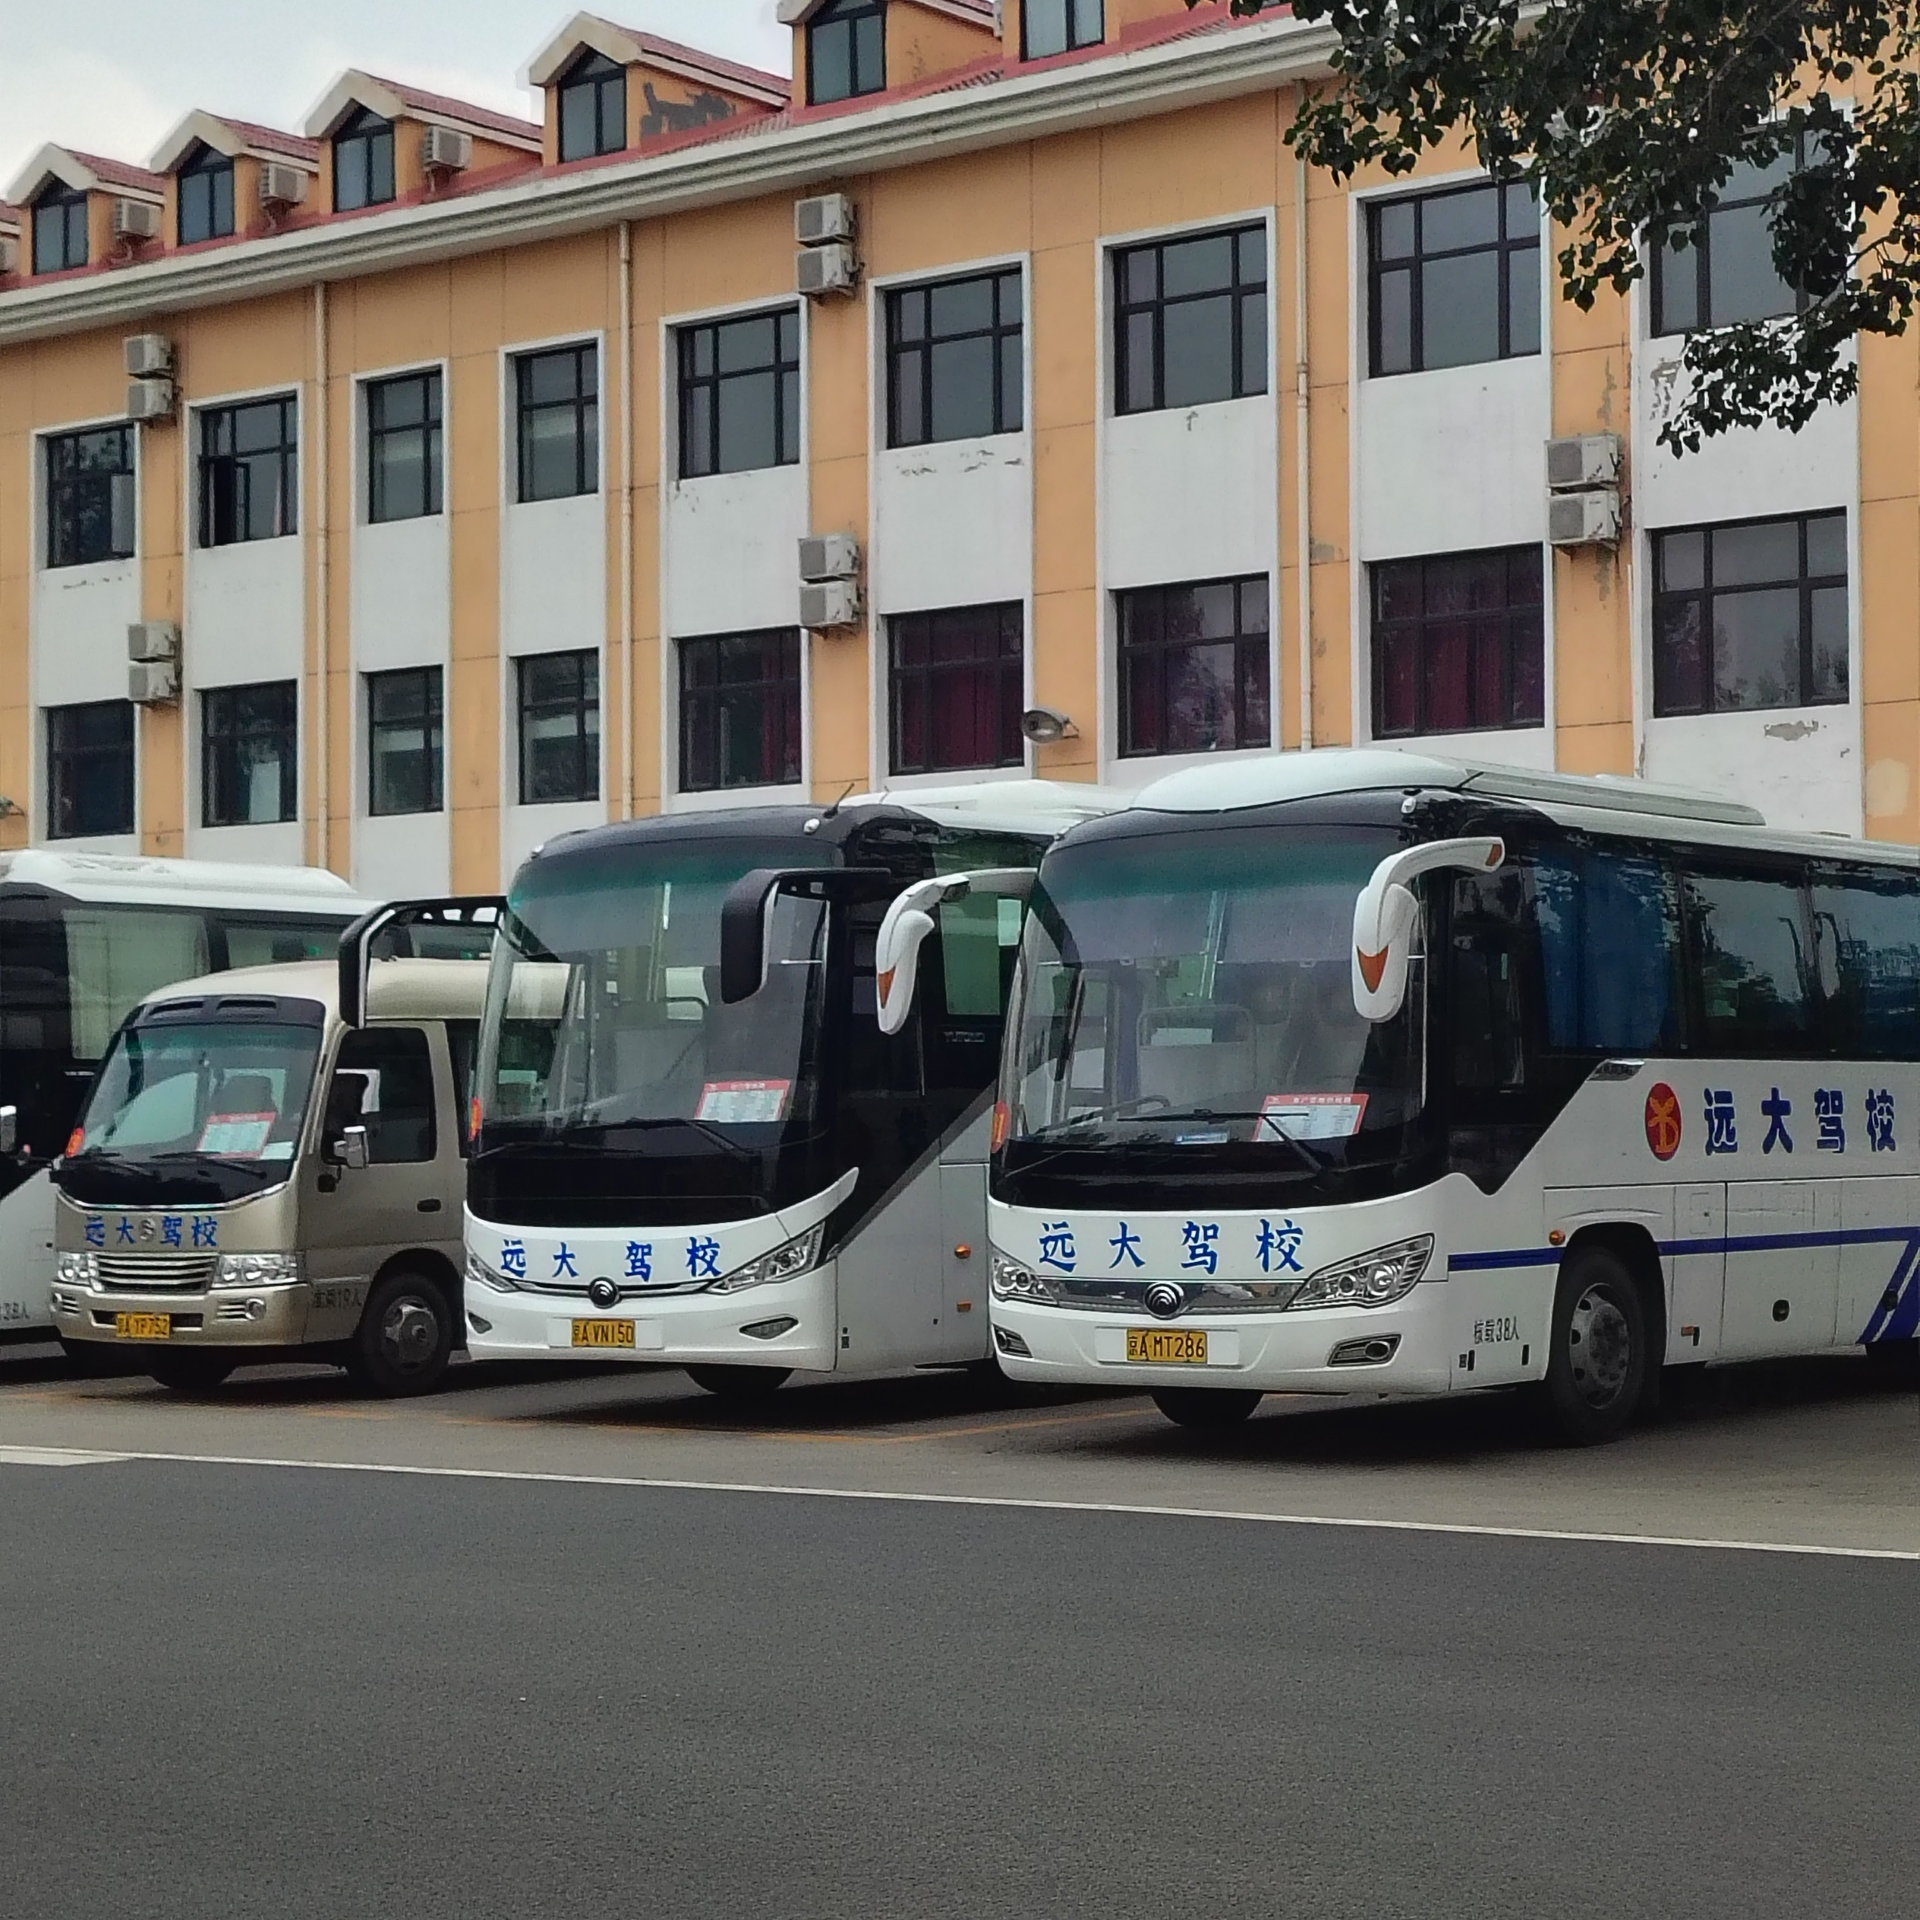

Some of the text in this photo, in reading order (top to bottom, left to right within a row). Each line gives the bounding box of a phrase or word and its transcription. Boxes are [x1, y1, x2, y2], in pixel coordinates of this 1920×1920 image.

[1703, 1086, 1897, 1156] 远大驾校
[84, 1214, 219, 1248] 远大驾校
[1038, 1217, 1305, 1276] 远大驾校
[499, 1235, 723, 1284] 远大驾校
[1473, 1315, 1520, 1345] 核载38人
